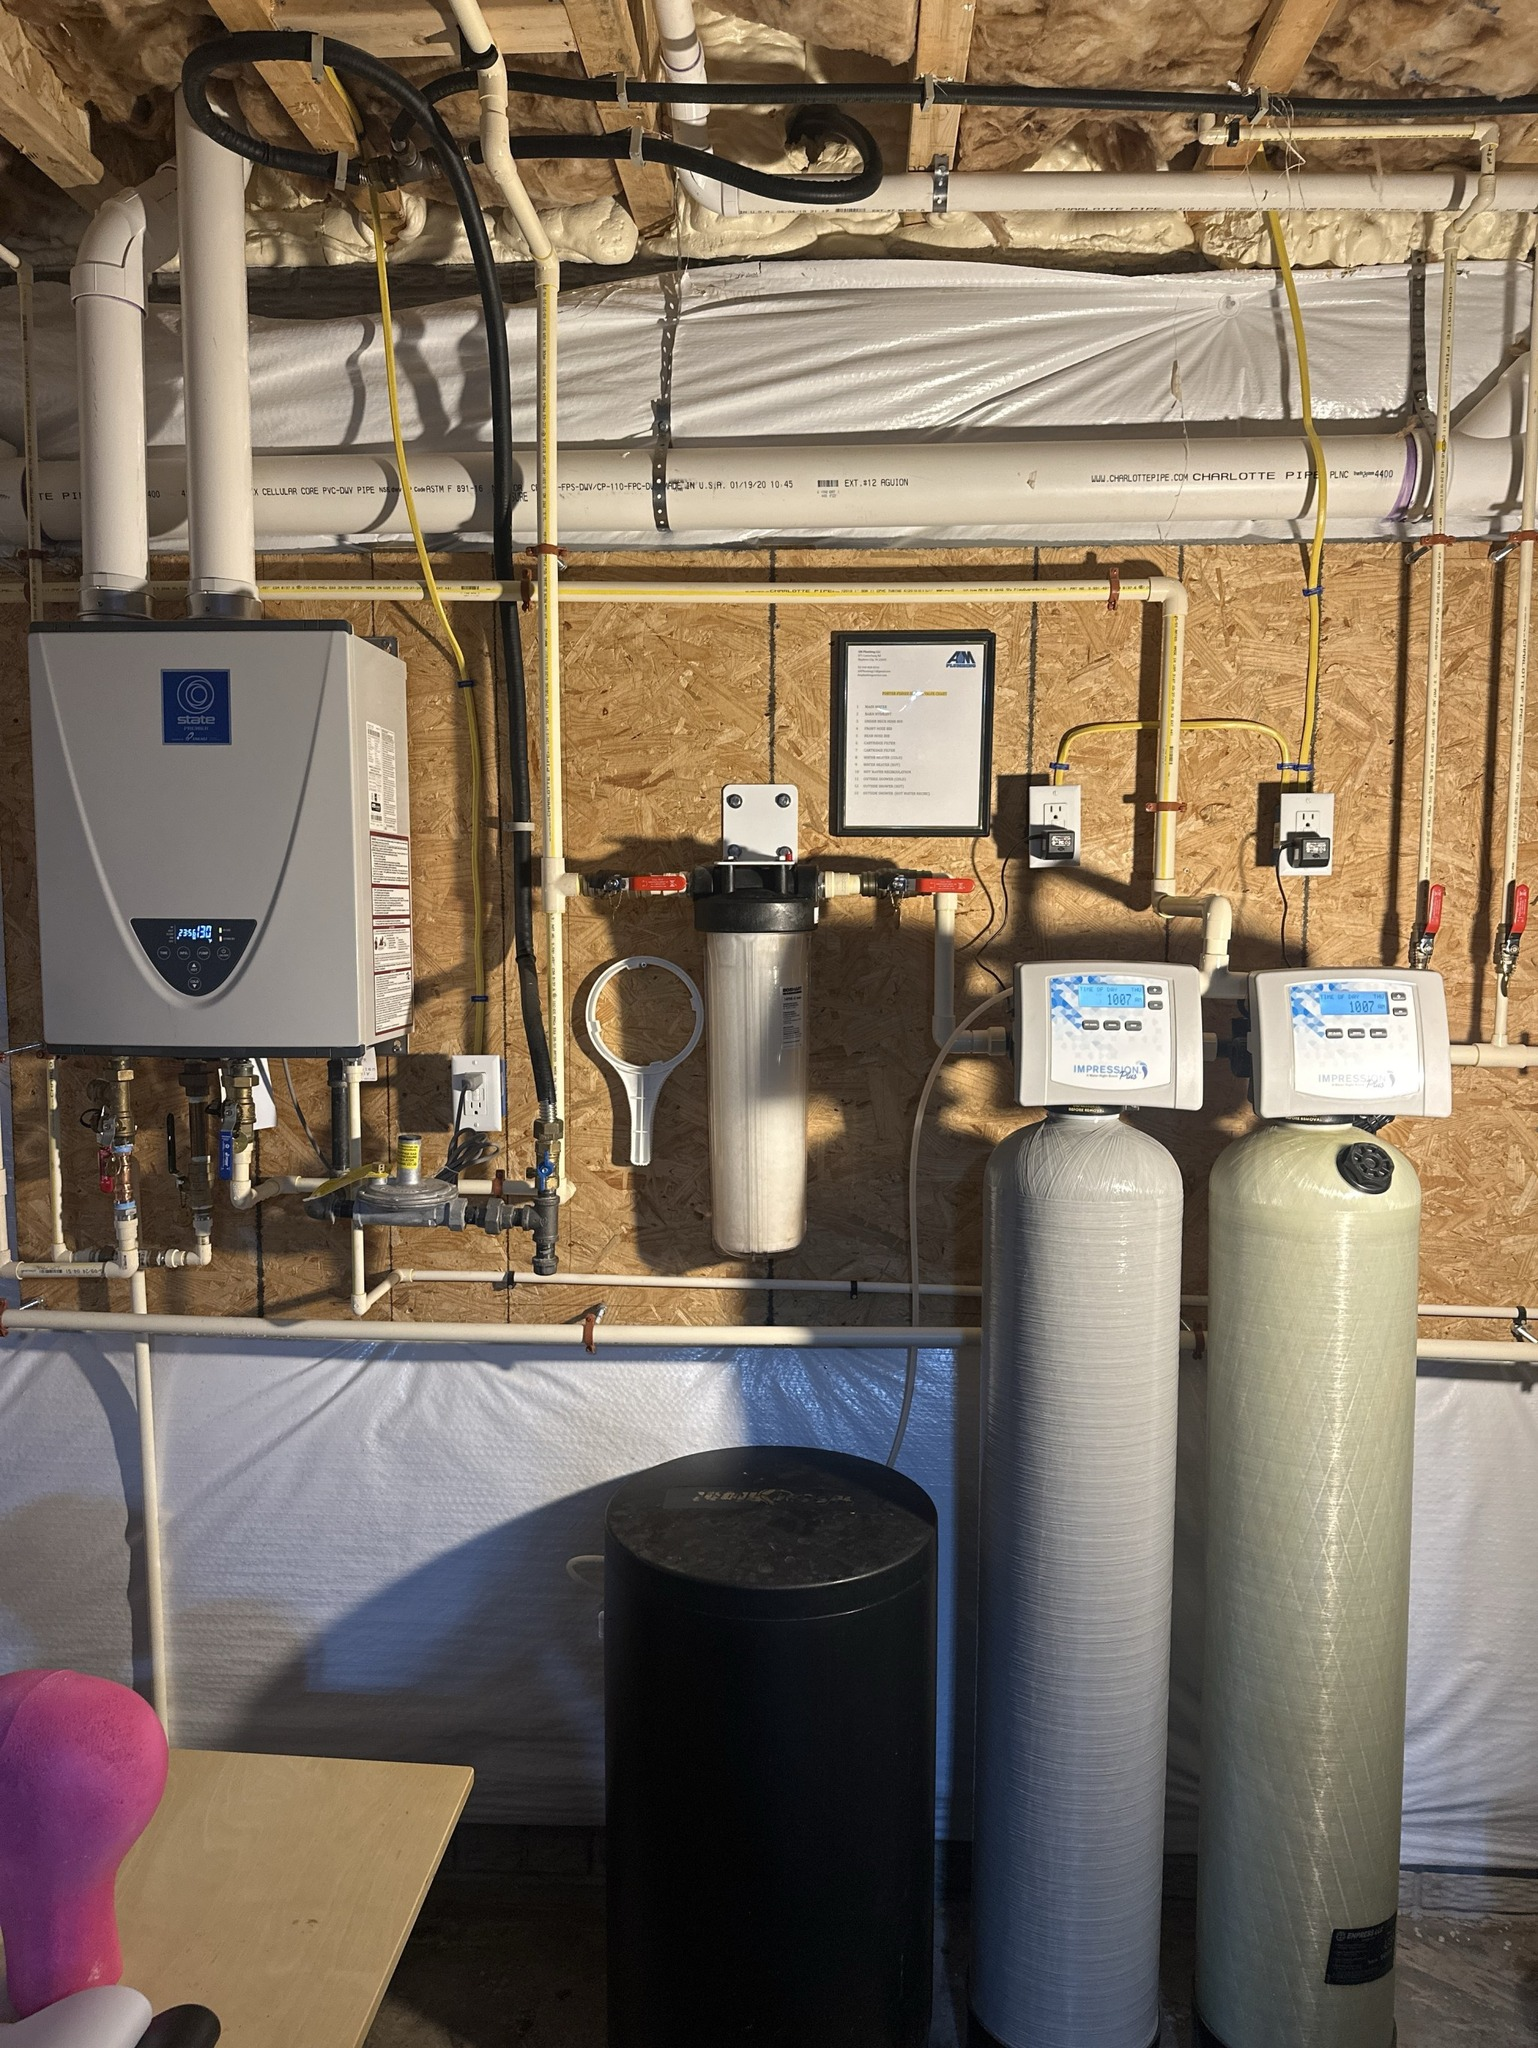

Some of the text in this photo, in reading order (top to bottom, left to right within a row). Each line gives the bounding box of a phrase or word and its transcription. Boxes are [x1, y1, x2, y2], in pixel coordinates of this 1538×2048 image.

[1091, 474, 1188, 482] WWW.CHARLOTTEPIPE.COM
[1192, 472, 1276, 481] CHARLOTTE
[1285, 471, 1320, 480] PIPE
[1330, 470, 1348, 478] PLNC
[1374, 470, 1394, 478] 4400
[262, 487, 298, 496] CELLULAR
[300, 487, 318, 495] CORE
[322, 487, 353, 495] PVC-DWV
[357, 486, 375, 494] PIPE
[730, 481, 766, 489] 01/19/20
[177, 715, 216, 724] state
[196, 925, 212, 938] 130
[1108, 994, 1132, 1006] 1007
[1350, 1001, 1374, 1013] 1007
[1074, 1065, 1139, 1074] IMPRESSION
[1119, 1070, 1137, 1080] Plus
[1318, 1074, 1385, 1082] IMPRESSION
[1366, 1079, 1384, 1088] Plus
